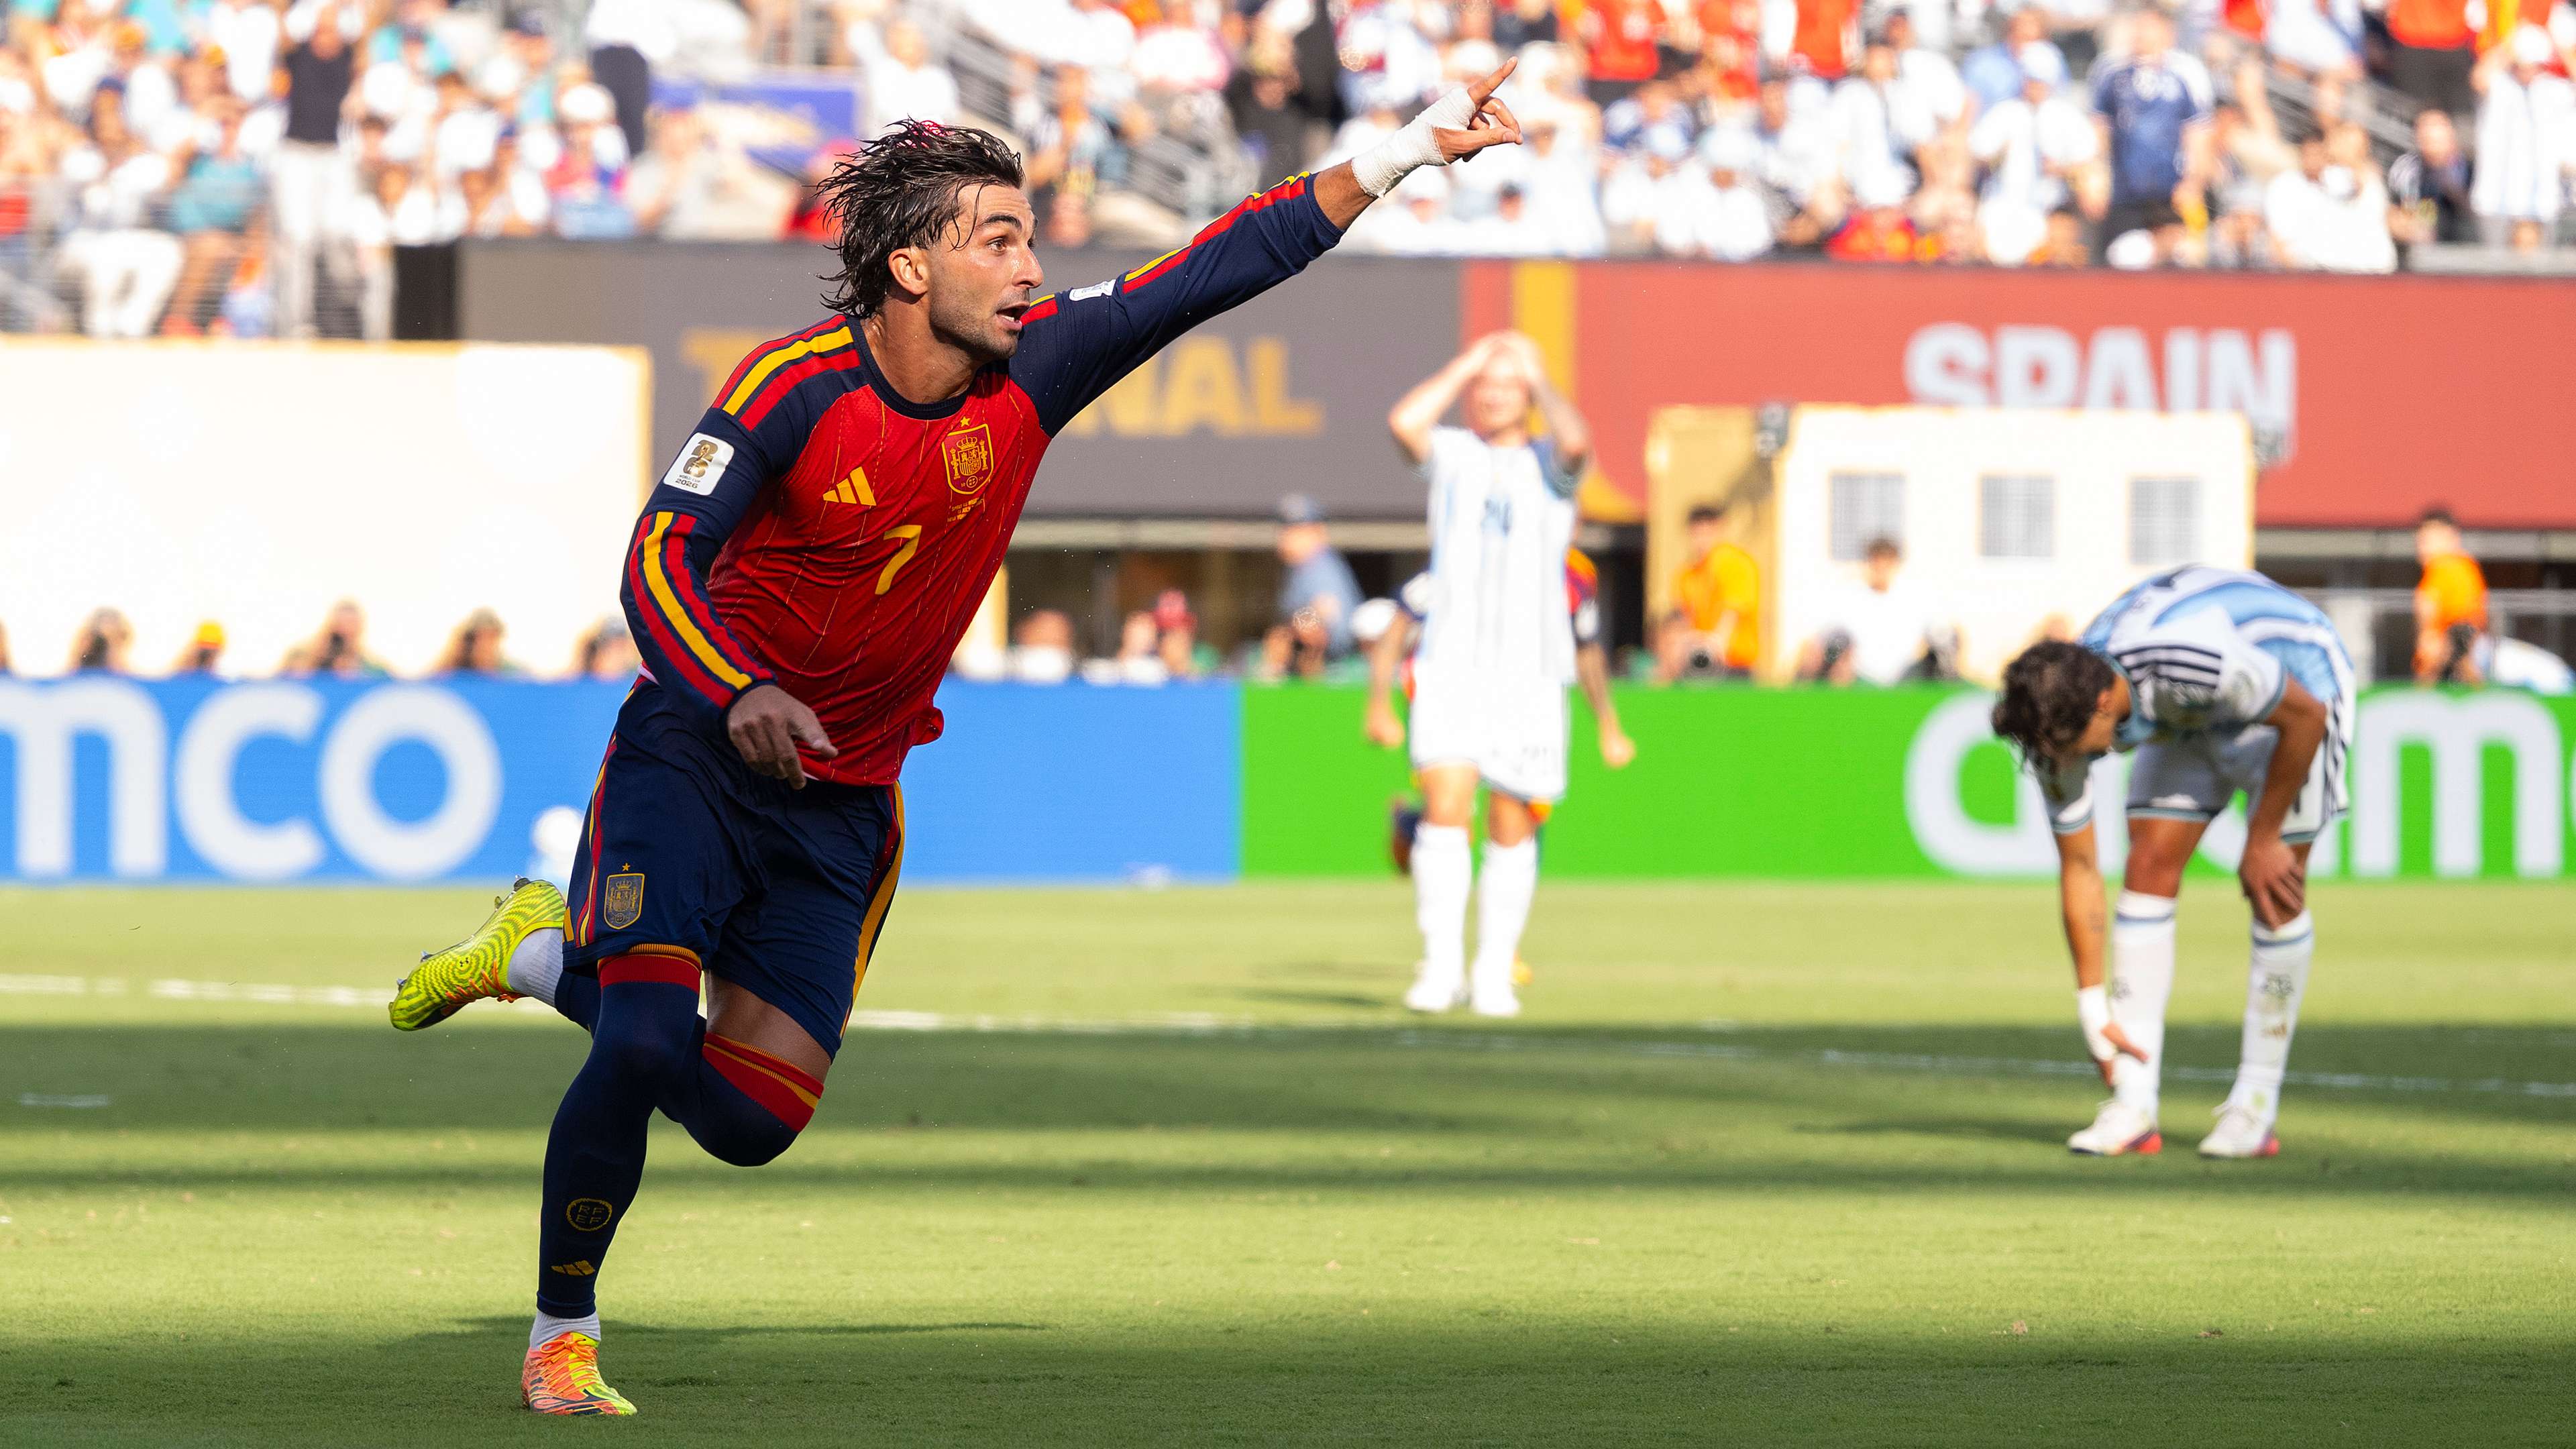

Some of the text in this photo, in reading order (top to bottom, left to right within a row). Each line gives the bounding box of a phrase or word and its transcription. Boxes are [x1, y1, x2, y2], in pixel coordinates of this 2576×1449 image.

[1904, 323, 2298, 464] SPAIN
[675, 478, 698, 489] 2026
[874, 525, 922, 595] 7
